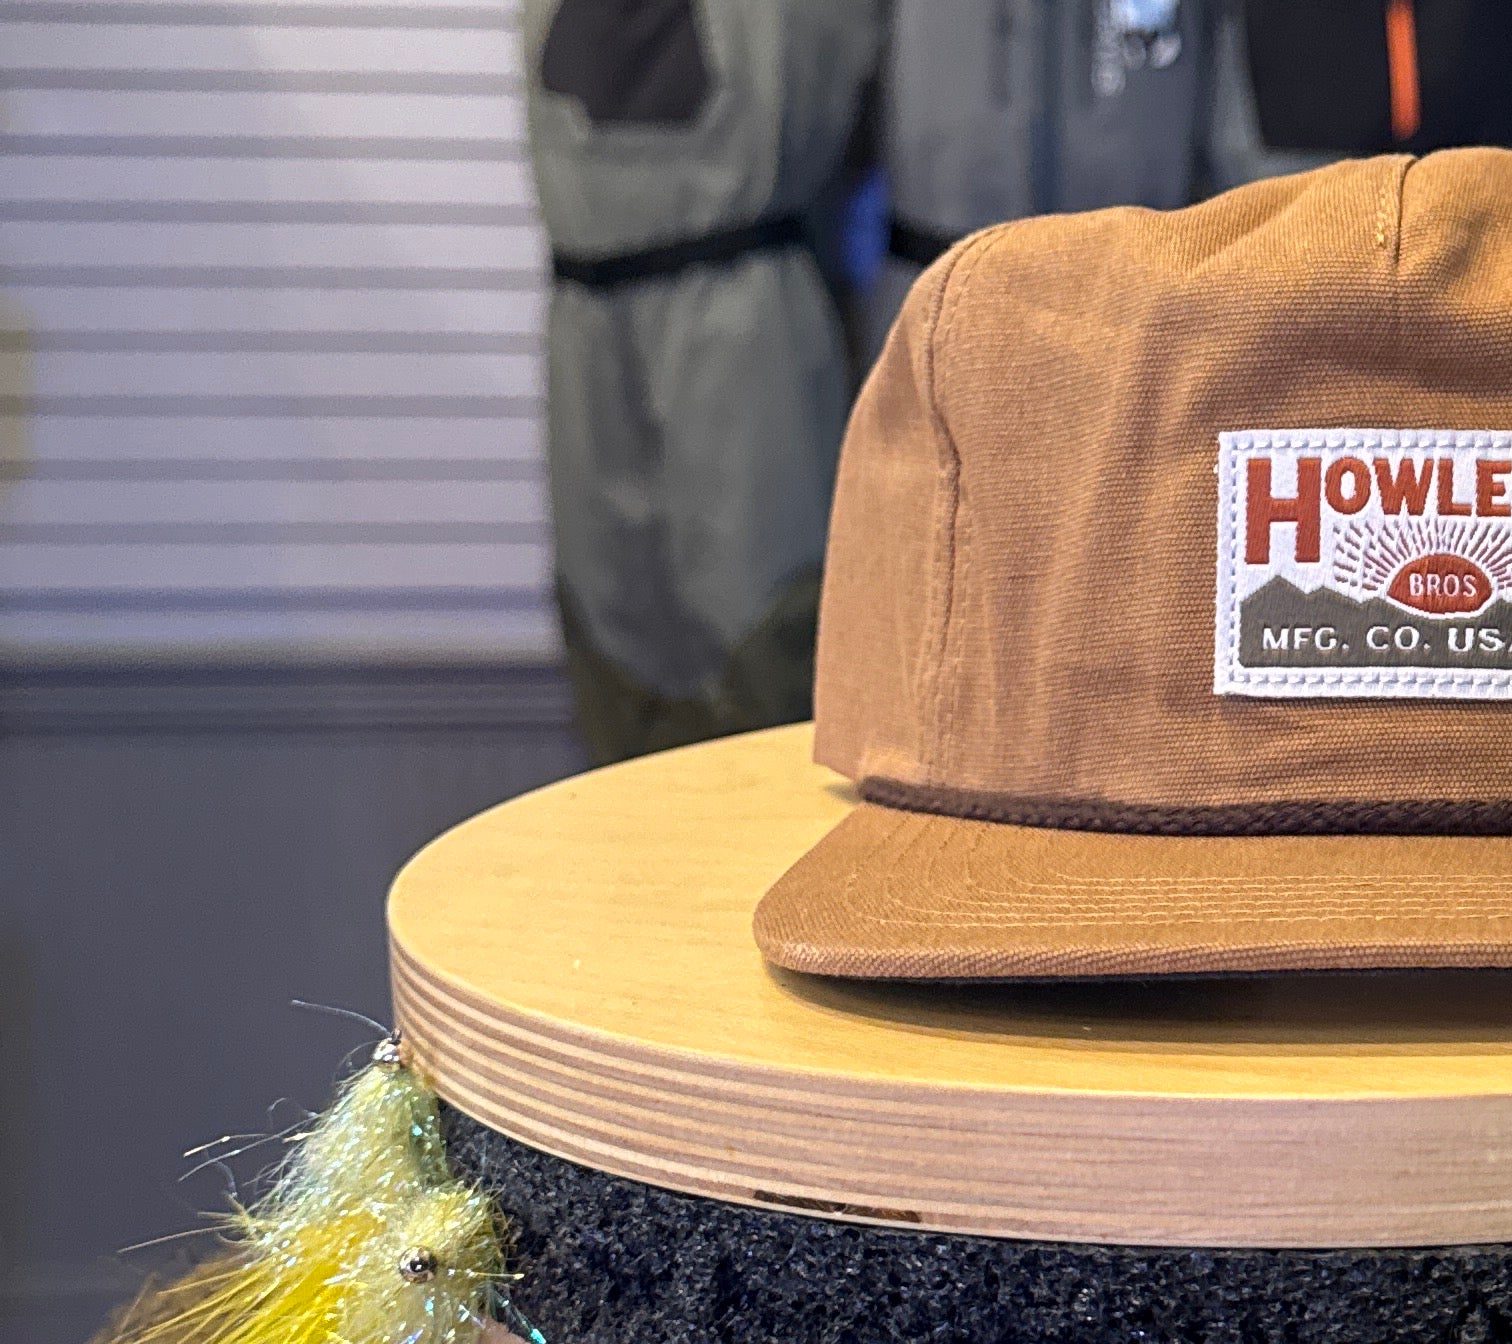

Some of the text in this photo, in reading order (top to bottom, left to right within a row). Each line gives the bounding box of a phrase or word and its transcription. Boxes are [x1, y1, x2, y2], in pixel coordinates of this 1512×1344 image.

[1408, 572, 1477, 599] BROS
[1262, 626, 1350, 652] MFG.
[1366, 625, 1431, 652] CO.
